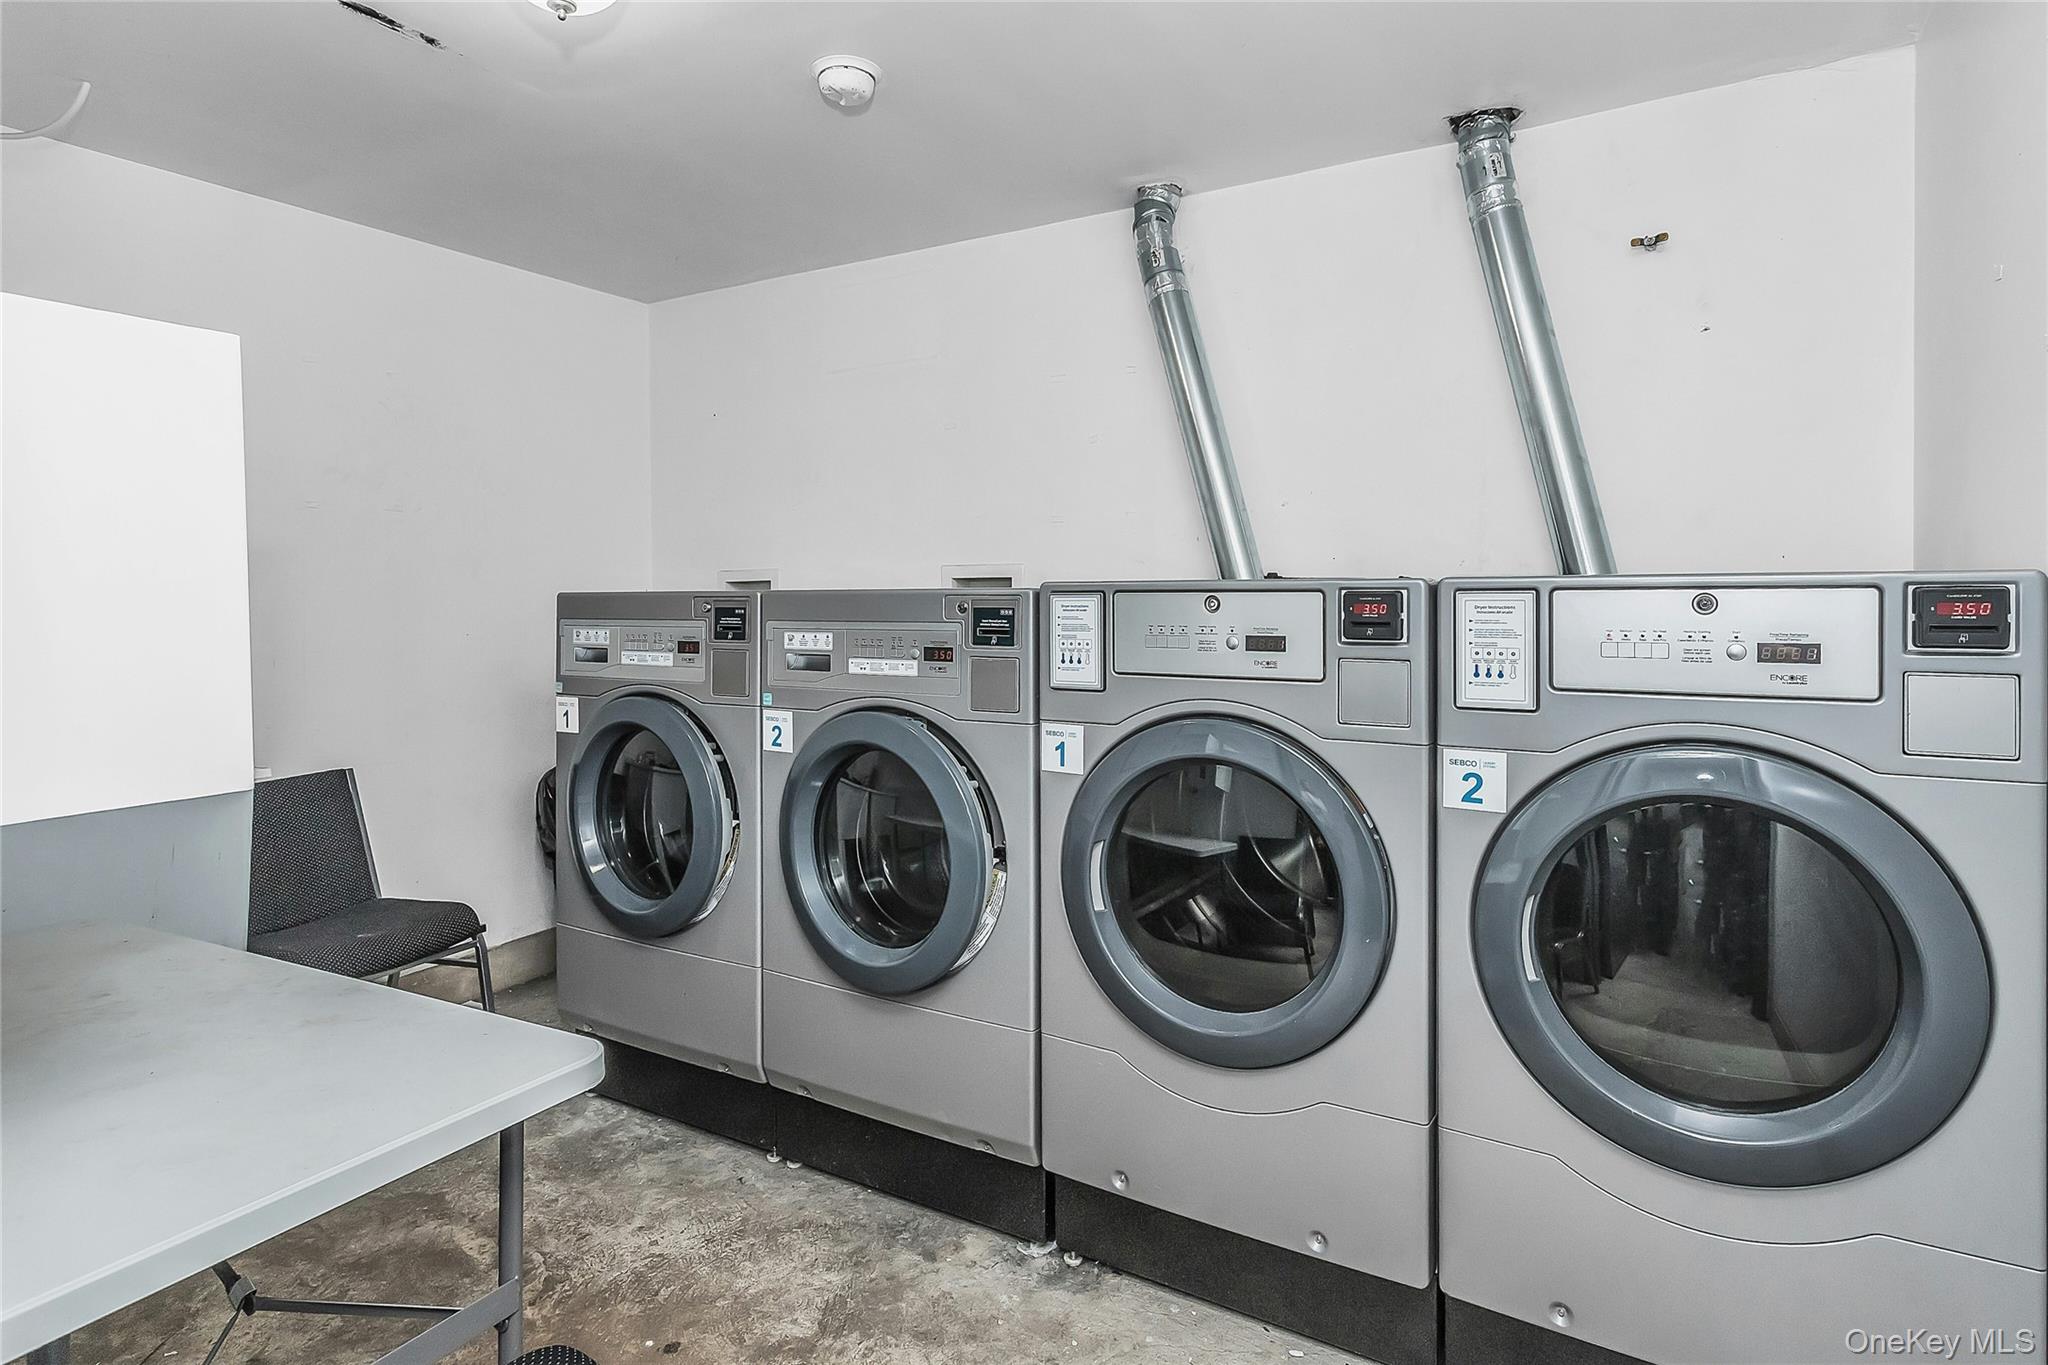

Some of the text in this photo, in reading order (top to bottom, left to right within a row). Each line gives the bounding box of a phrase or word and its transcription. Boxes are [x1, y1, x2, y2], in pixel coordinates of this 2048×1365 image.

[1363, 603, 1387, 614] 3.50
[1952, 602, 1992, 615] 3.50
[1770, 674, 1808, 682] ENCORE
[563, 709, 569, 728] 1
[771, 725, 782, 747] 2
[1055, 741, 1065, 767] 1
[1448, 758, 1478, 768] SEBCO
[1460, 772, 1484, 804] 2
